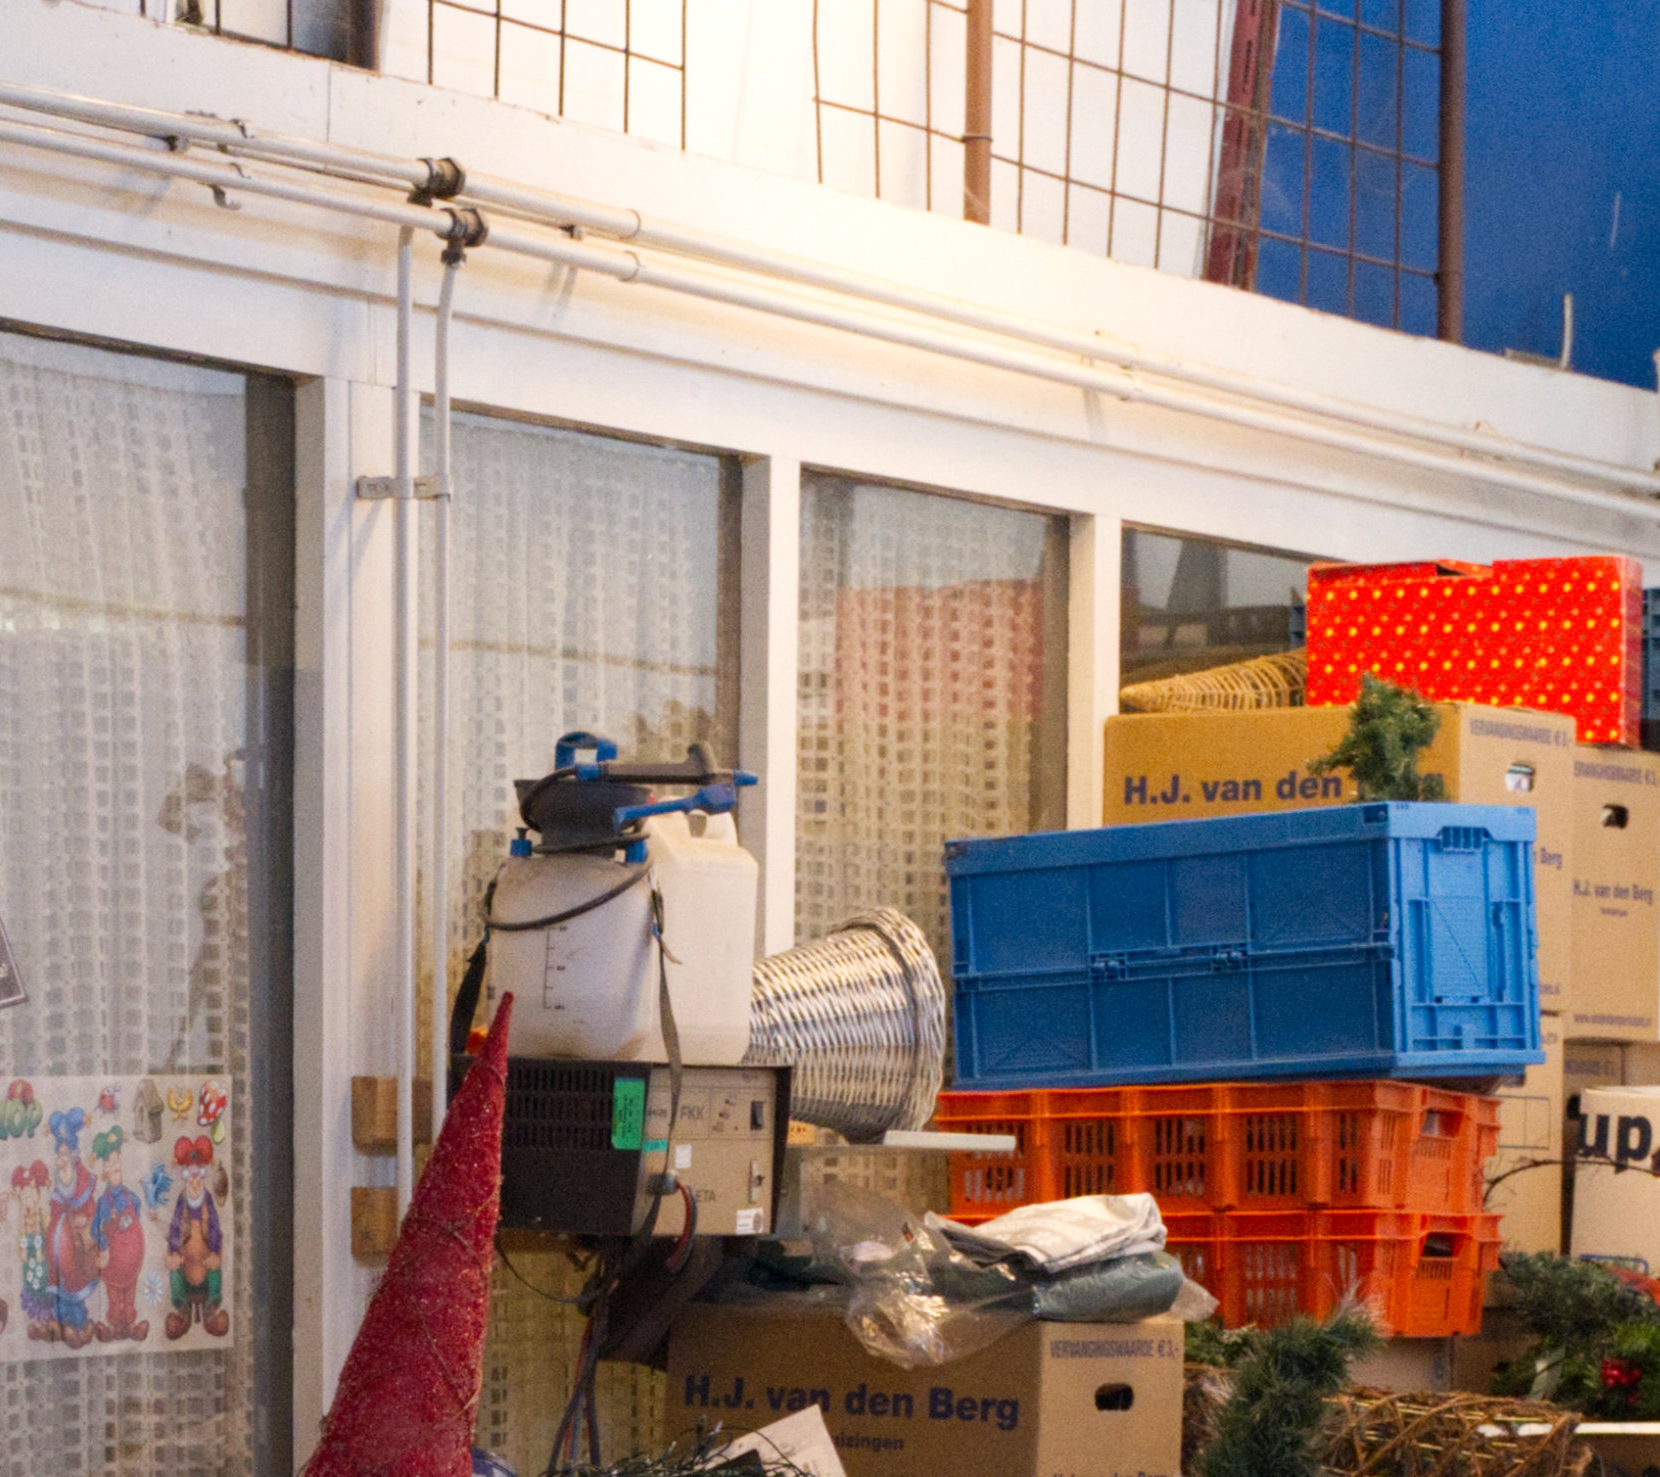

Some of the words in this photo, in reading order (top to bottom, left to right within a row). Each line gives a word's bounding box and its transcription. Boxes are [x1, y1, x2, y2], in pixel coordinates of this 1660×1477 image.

[1123, 774, 1191, 805] H.J.
[1200, 781, 1263, 803] van
[1275, 770, 1343, 800] den
[1577, 1111, 1654, 1174] up
[695, 1189, 716, 1203] ETA
[683, 1375, 754, 1410] H.J.
[766, 1385, 831, 1416] van
[845, 1383, 915, 1419] den
[929, 1386, 1020, 1432] Berg
[833, 1431, 906, 1453] uizingen
